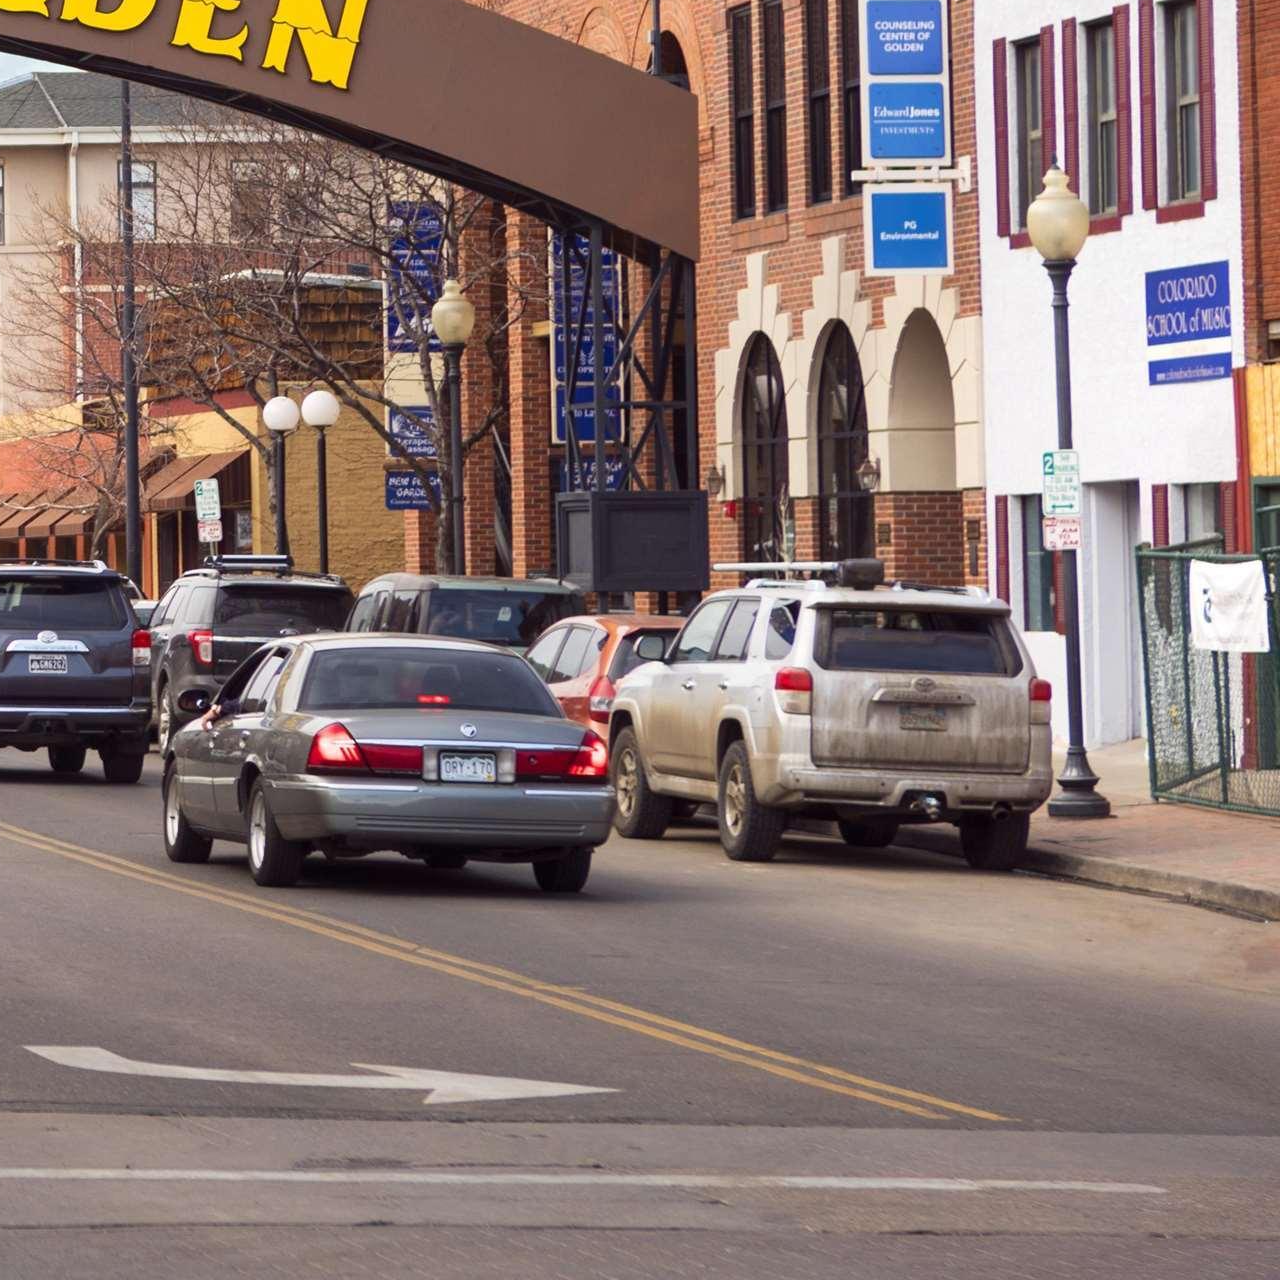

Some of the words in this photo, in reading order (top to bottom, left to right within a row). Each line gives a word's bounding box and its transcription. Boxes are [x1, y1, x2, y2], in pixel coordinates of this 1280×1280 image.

[874, 21, 936, 31] COUNSELING
[879, 32, 915, 41] CENTER
[917, 32, 931, 41] OF
[884, 43, 924, 52] GOLDEN
[904, 221, 917, 229] PG
[880, 231, 939, 240] Environmental
[1158, 274, 1217, 303] COLORADO
[1147, 312, 1187, 338] SCHOOL
[1189, 308, 1200, 333] of
[1201, 306, 1231, 331] MUSIC
[1044, 455, 1053, 473] 2
